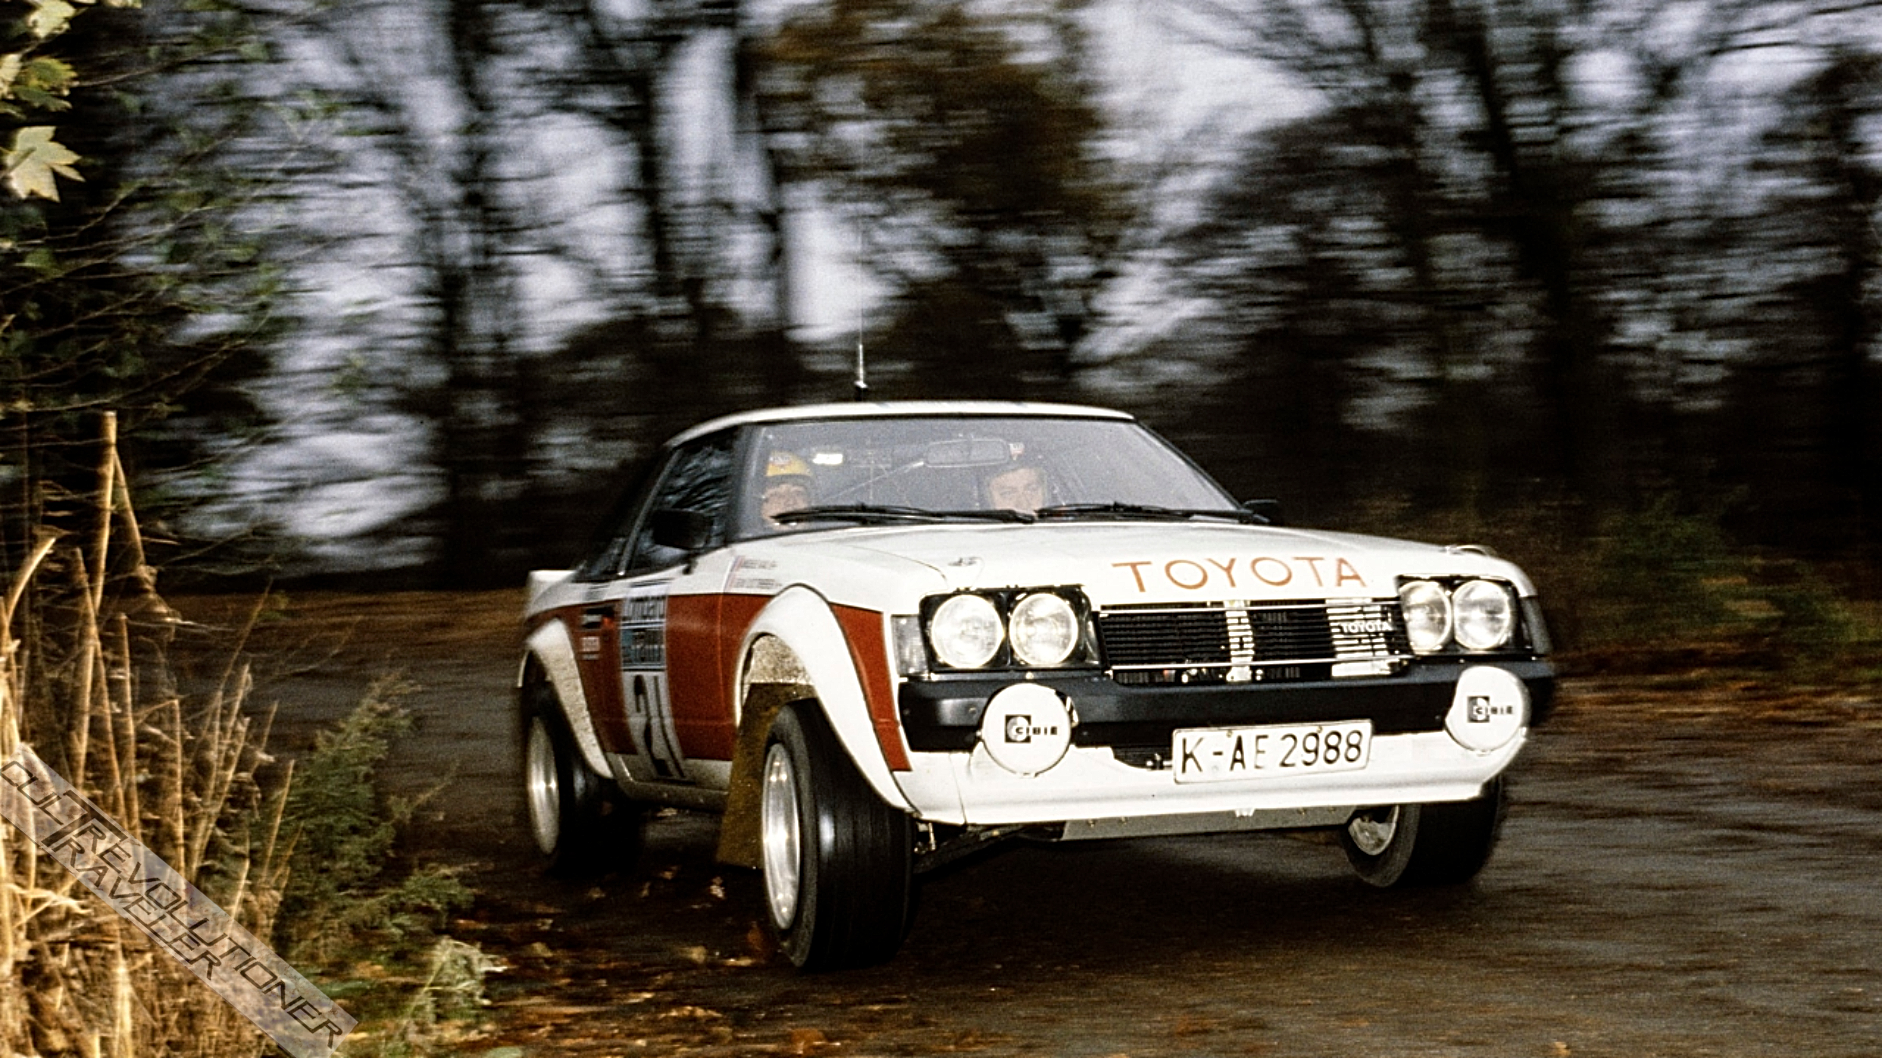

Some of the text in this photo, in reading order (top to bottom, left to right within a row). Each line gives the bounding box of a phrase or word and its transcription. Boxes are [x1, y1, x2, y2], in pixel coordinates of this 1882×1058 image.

[1111, 556, 1367, 593] TOYOTA
[1341, 619, 1393, 633] TOYOTA
[1278, 729, 1364, 768] 2988
